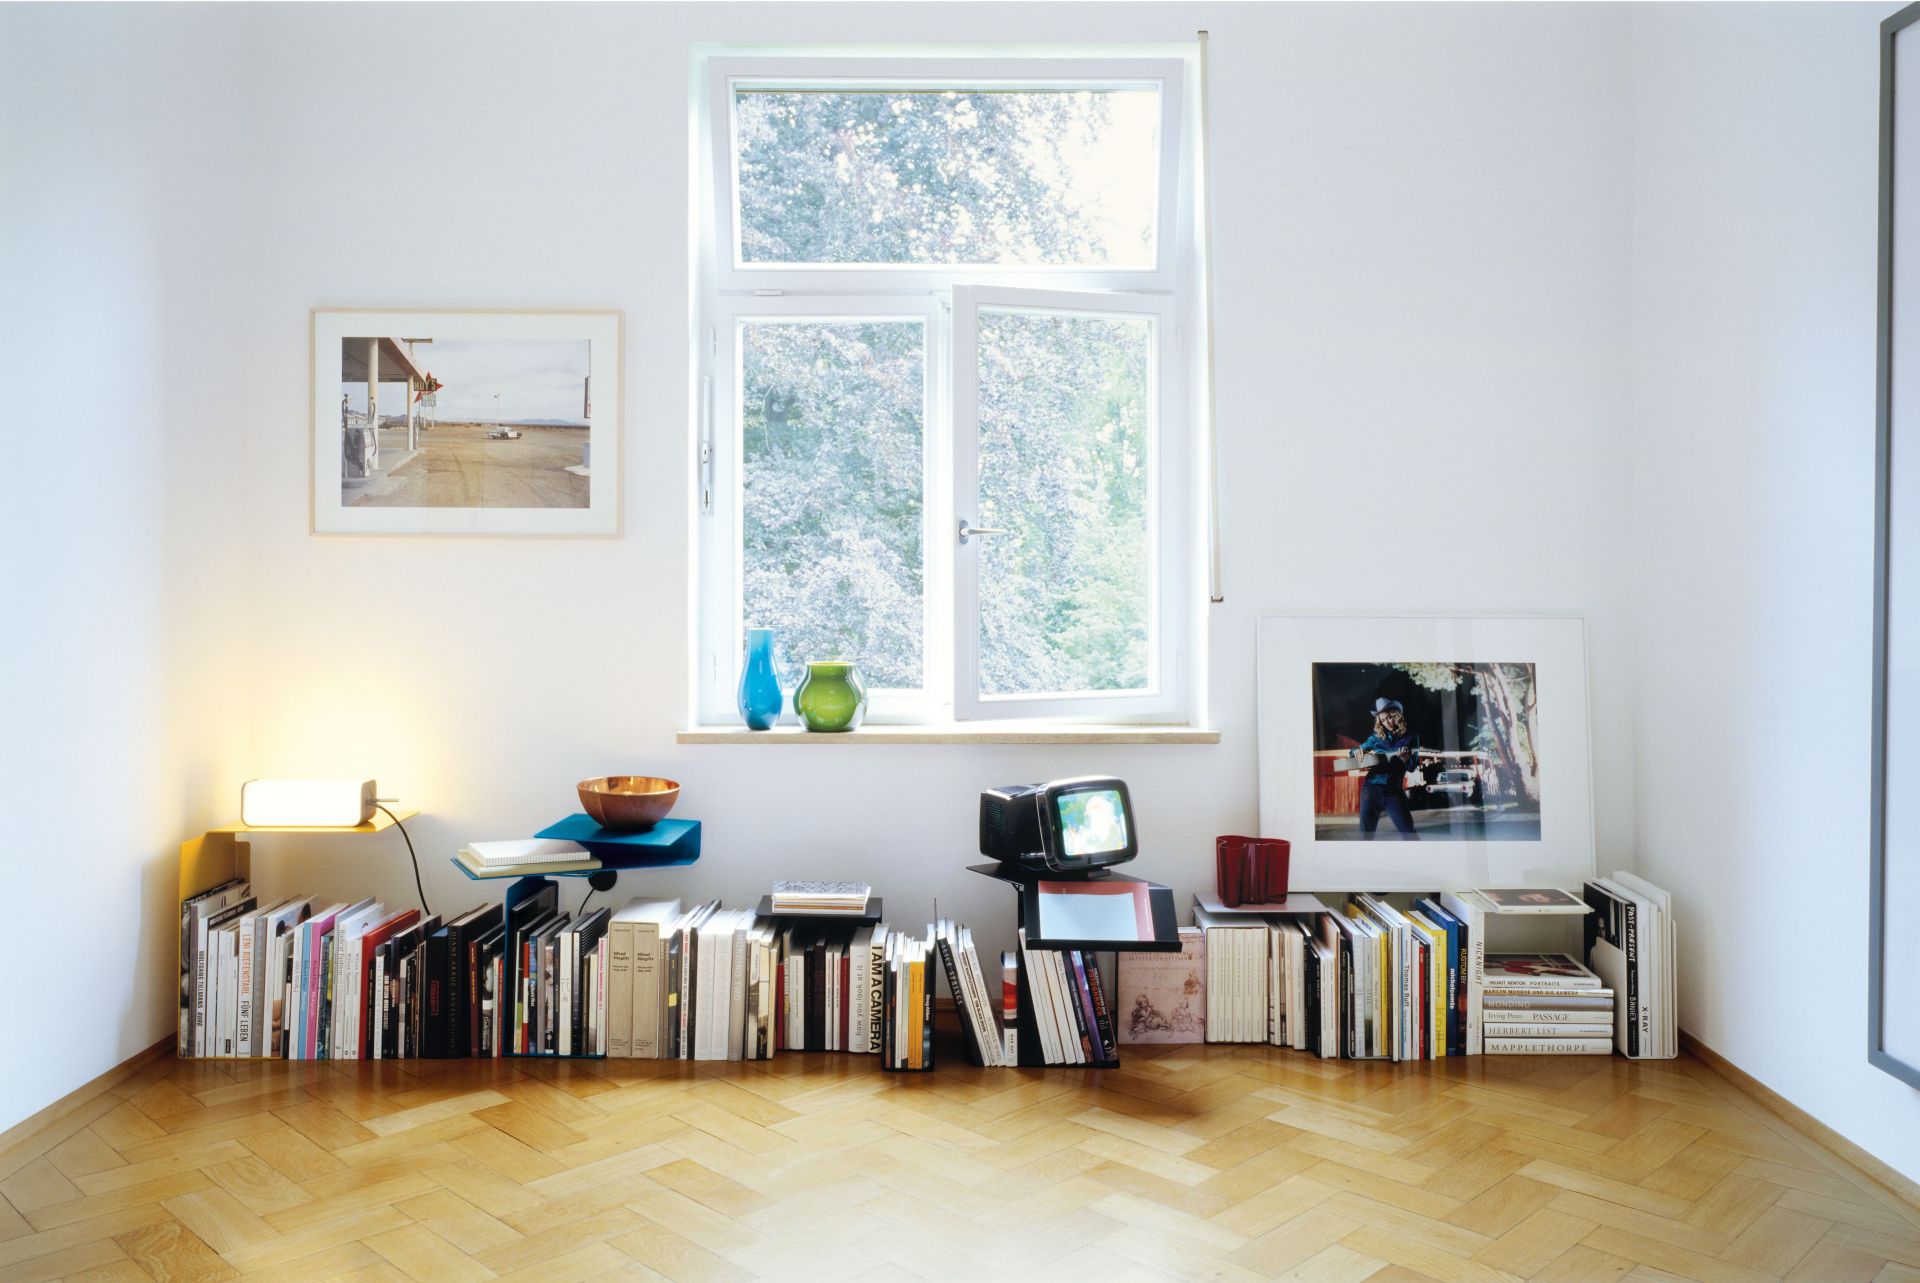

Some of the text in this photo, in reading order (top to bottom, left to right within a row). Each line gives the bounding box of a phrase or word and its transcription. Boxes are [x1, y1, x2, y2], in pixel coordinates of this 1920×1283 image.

[1627, 906, 1636, 963] PAST-PRESENT
[871, 952, 882, 975] AM
[856, 973, 863, 981] at
[871, 977, 882, 987] A
[239, 934, 251, 1041] LENI RIEFENSTAHL FÜNF LEBEN
[855, 984, 863, 1001] look
[948, 971, 963, 1005] SPRINGS
[1487, 1000, 1531, 1008] MONDINO
[1629, 996, 1637, 1022] BANIER
[869, 989, 882, 1051] CAMERA
[1488, 1012, 1506, 1020] Irving
[1533, 1013, 1569, 1021] PASSAGE
[1641, 1006, 1649, 1033] X-RAY
[1488, 1027, 1557, 1035] HERBERT LIST
[1491, 1044, 1588, 1052] MAPPLETHORPE
